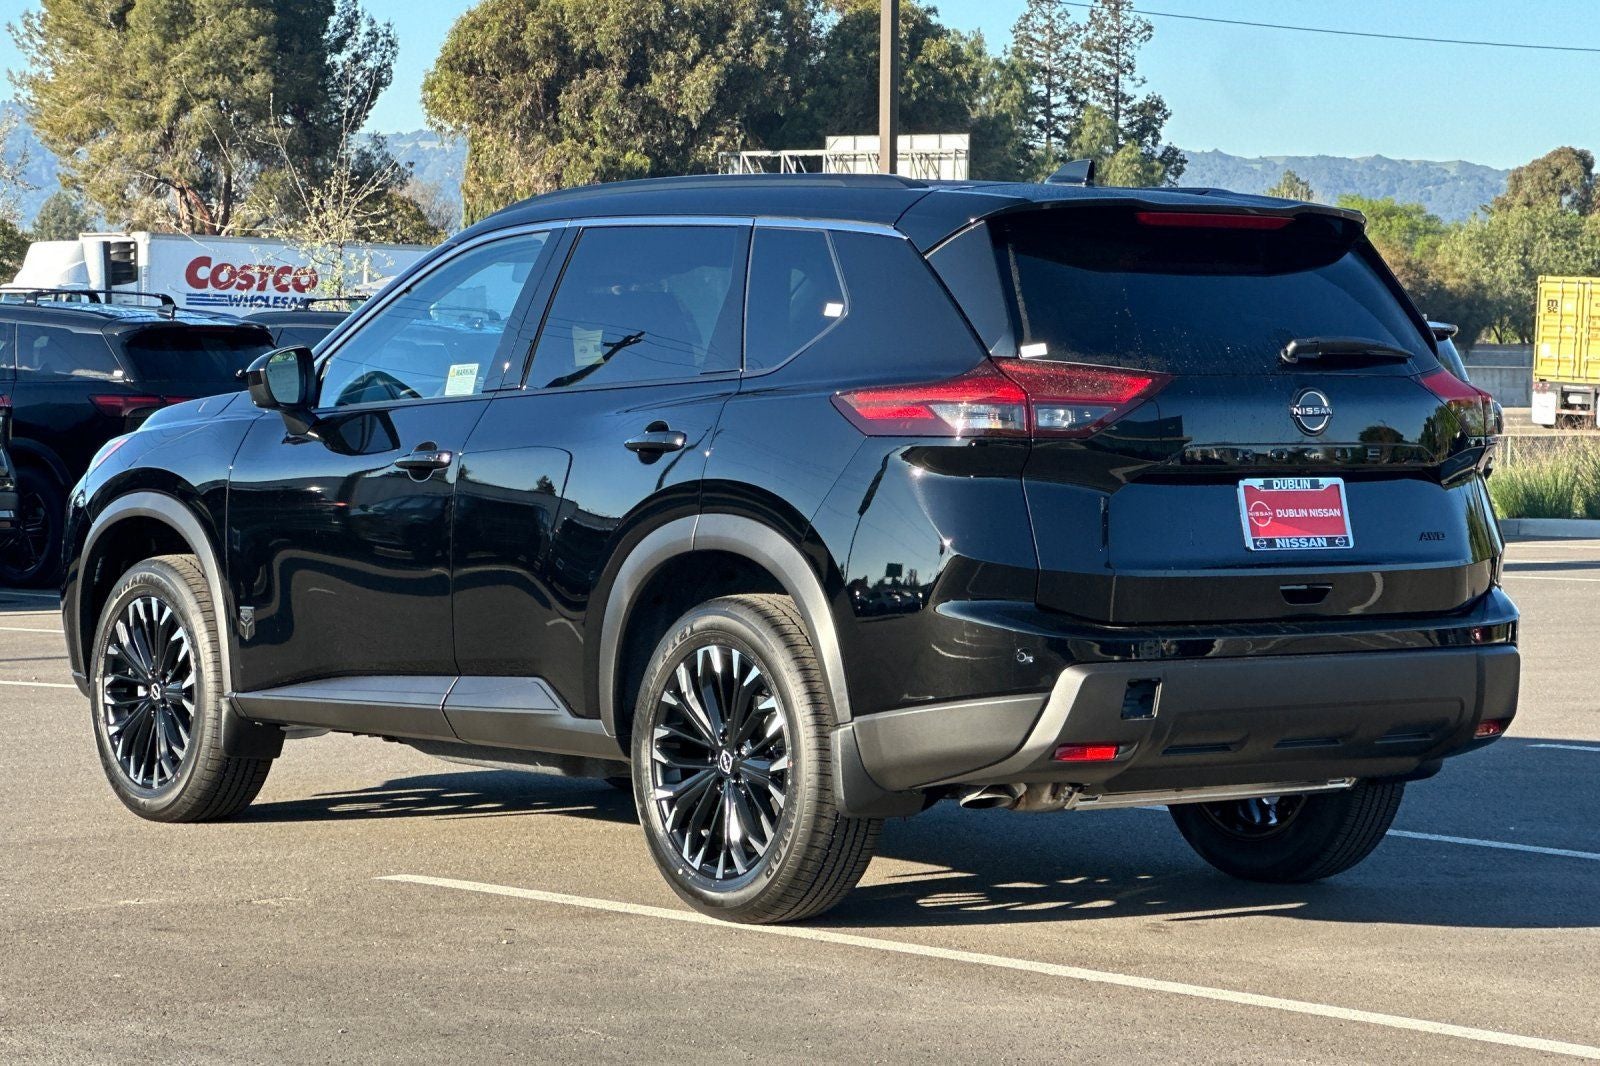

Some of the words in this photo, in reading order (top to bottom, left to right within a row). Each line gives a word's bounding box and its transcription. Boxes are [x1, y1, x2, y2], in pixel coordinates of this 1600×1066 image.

[185, 256, 318, 293] COSTCO
[227, 294, 308, 309] WHOLESA
[1293, 407, 1333, 415] NISSAN
[1273, 480, 1311, 489] DUBLIN
[1276, 508, 1308, 518] DUBLIN
[1310, 508, 1341, 517] NISSAN
[1276, 538, 1328, 548] NISSAN
